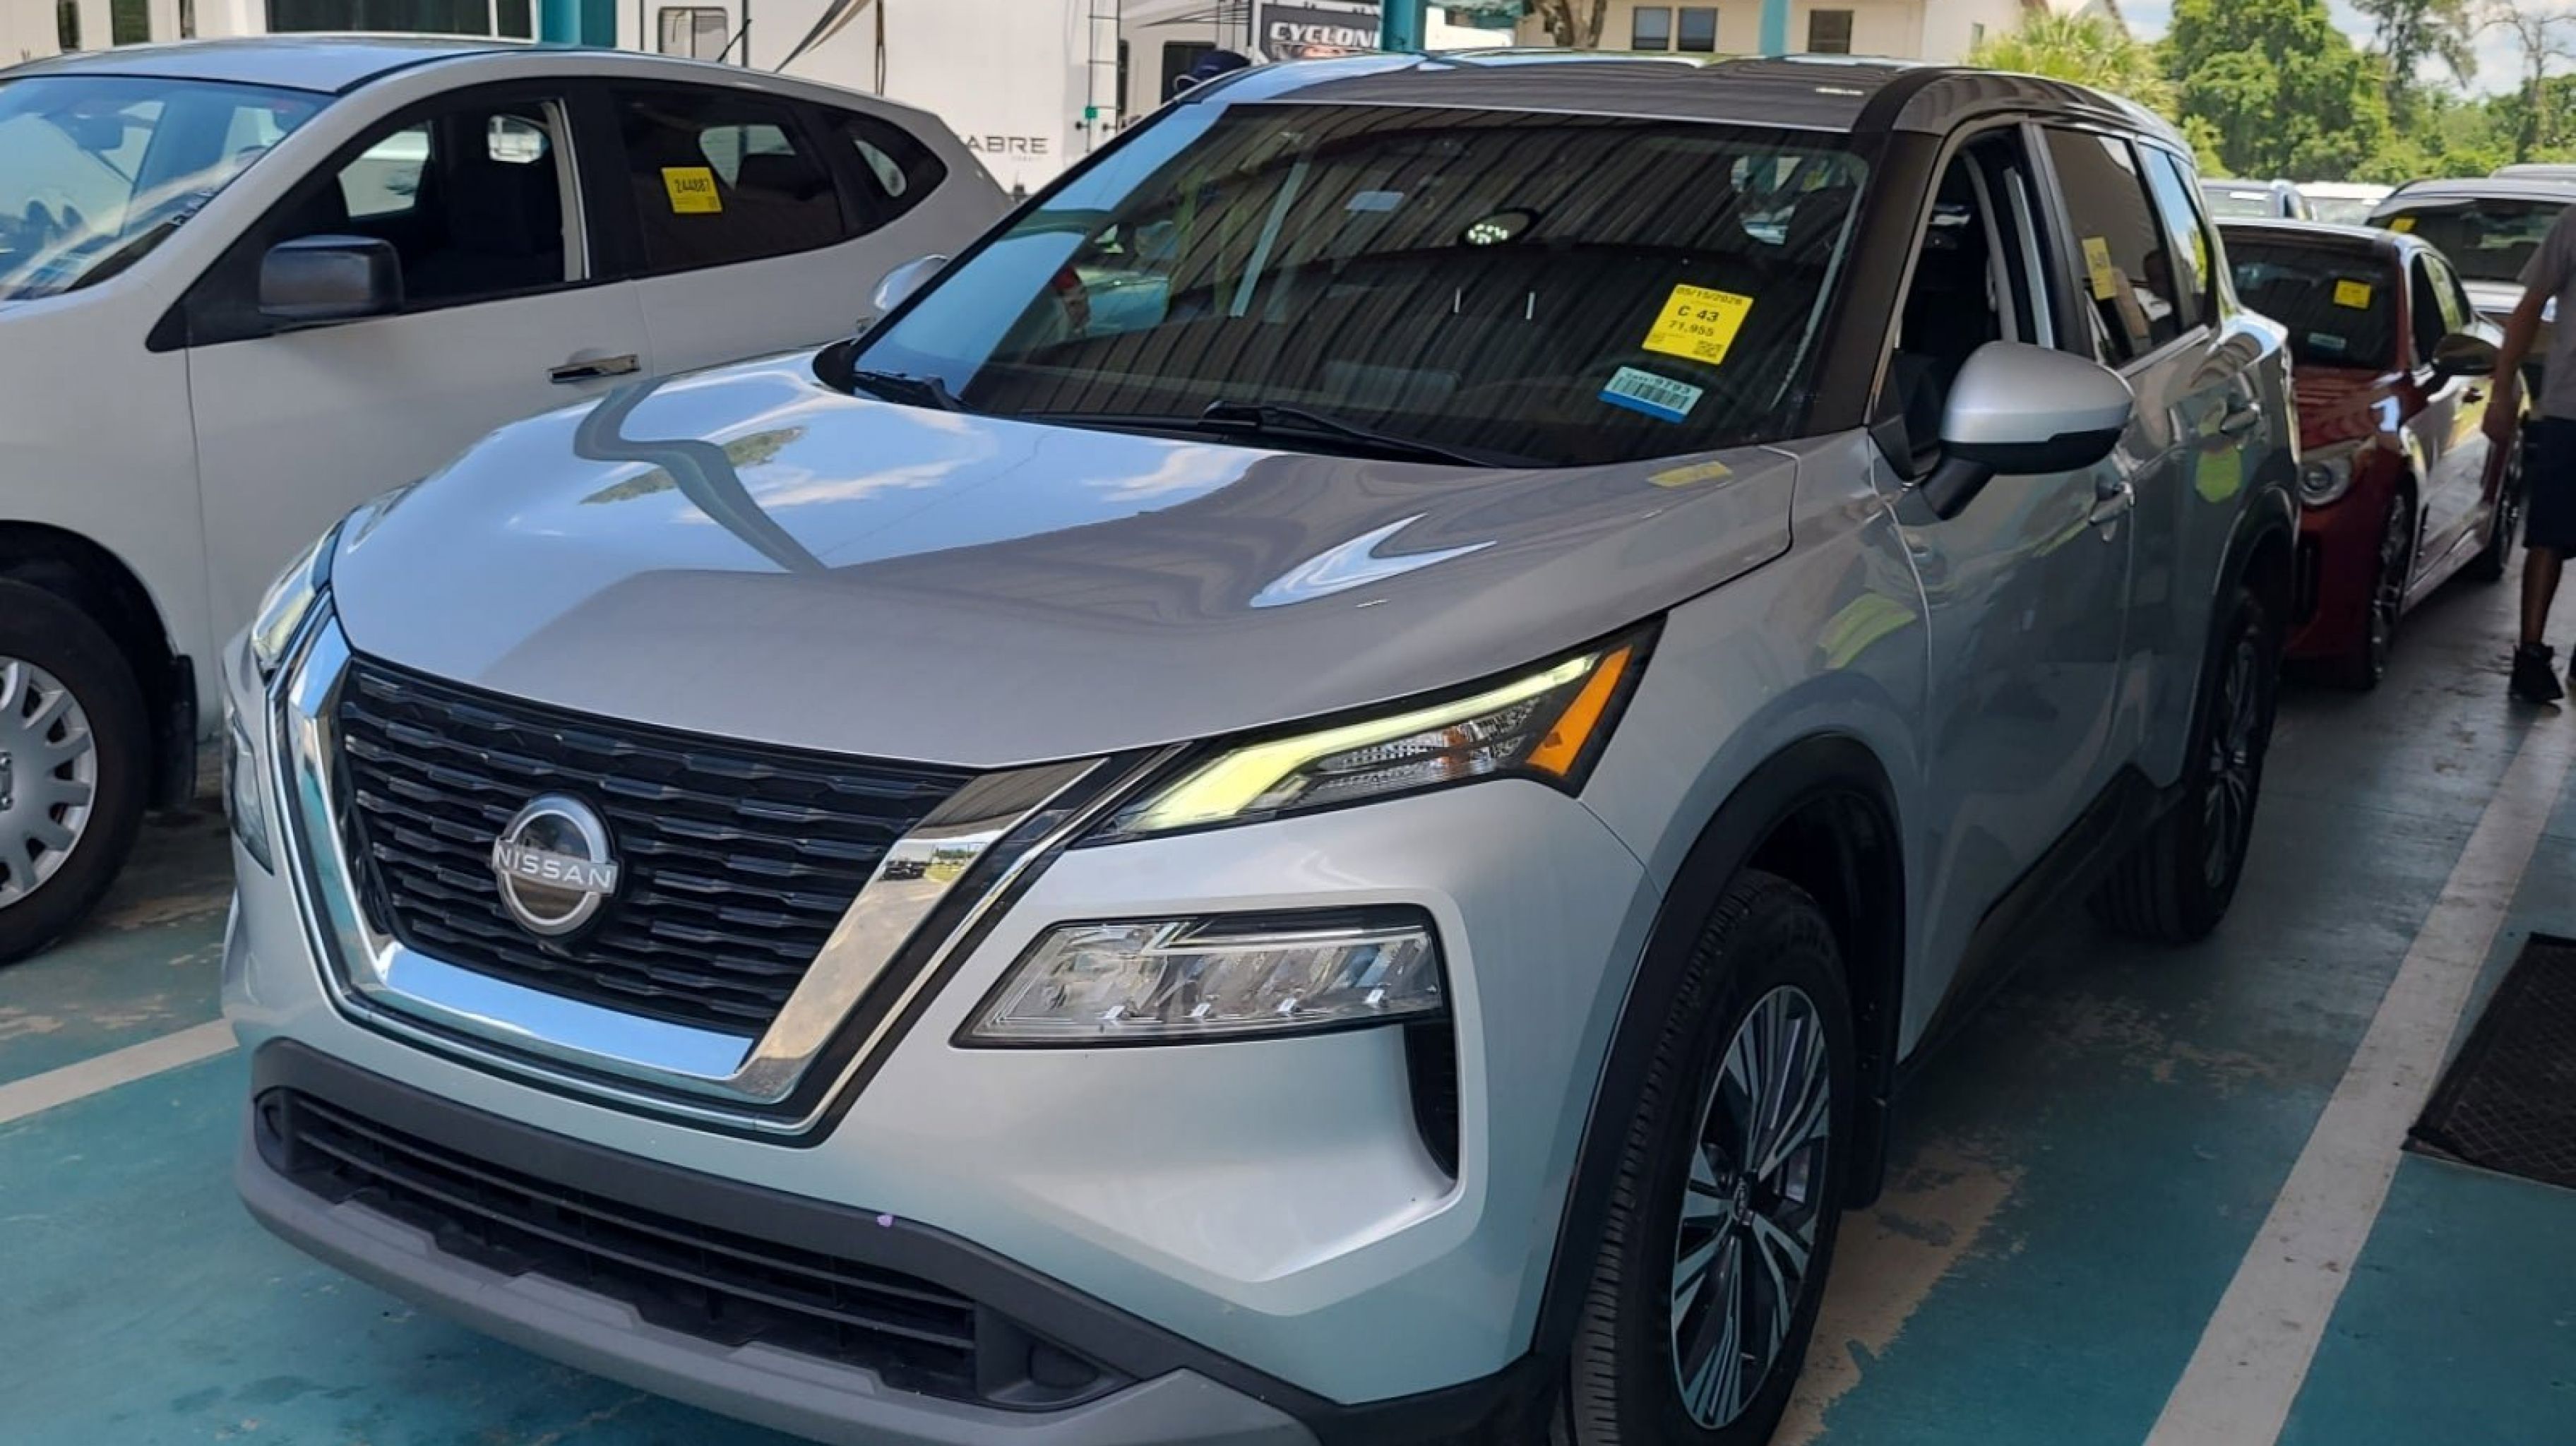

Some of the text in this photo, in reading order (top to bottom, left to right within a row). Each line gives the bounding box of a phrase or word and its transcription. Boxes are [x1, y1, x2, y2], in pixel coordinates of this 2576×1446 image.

[1677, 304, 1691, 316] C
[1696, 309, 1719, 323] 43
[494, 844, 612, 888] NISSAN
